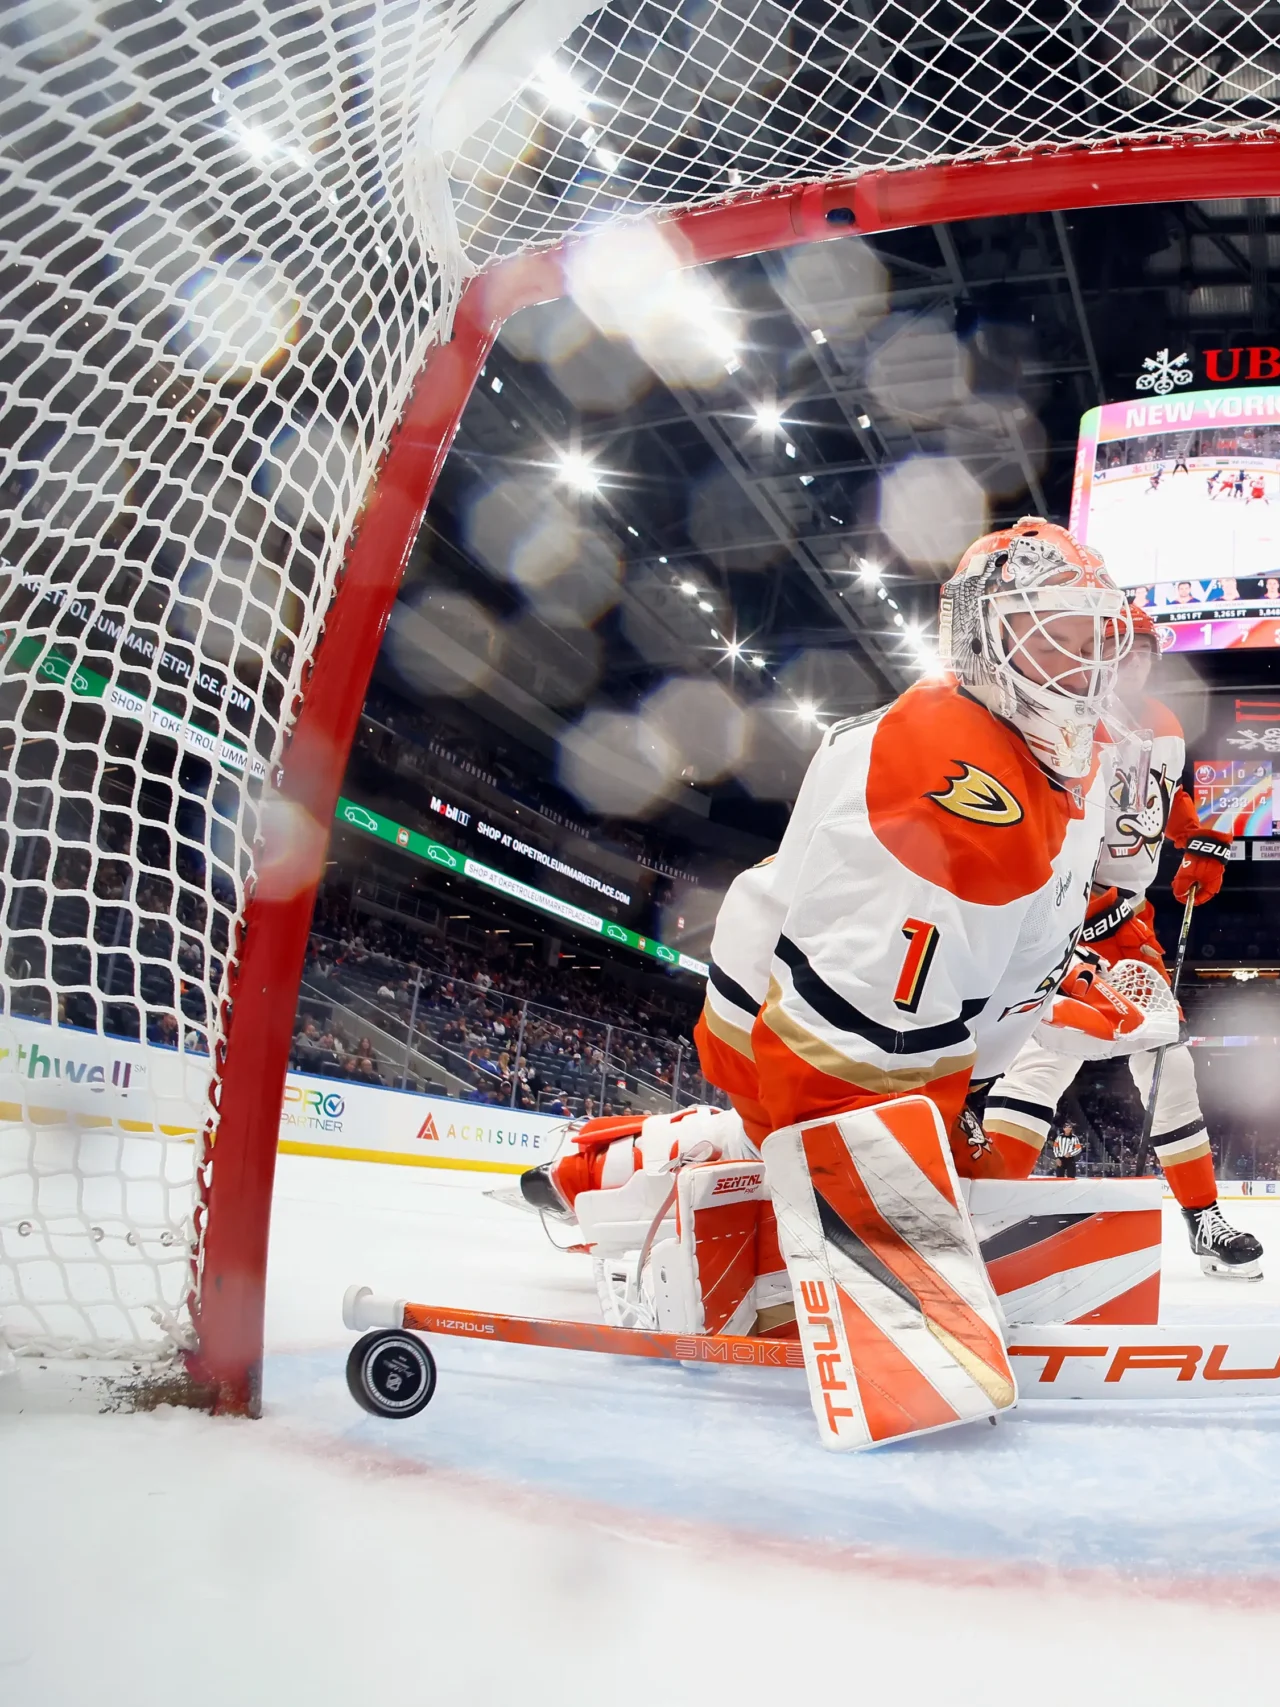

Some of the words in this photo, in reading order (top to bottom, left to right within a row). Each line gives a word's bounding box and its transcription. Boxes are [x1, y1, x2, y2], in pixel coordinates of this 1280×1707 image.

[1125, 400, 1196, 429] NEW
[1257, 579, 1264, 587] 4
[1192, 612, 1202, 620] FT
[1200, 623, 1212, 646] 1
[1241, 631, 1248, 642] 7
[110, 691, 143, 714] SHOP
[1222, 769, 1227, 778] 1
[1237, 769, 1245, 778] 0
[430, 796, 459, 823] Mobil
[1200, 797, 1206, 806] 7
[1219, 797, 1248, 808] 3:33
[1259, 797, 1266, 805] 4
[477, 821, 501, 841] SHOP
[501, 834, 512, 847] AT
[512, 838, 631, 906] OKPETROLEUMMARKETPLACE.COM
[637, 854, 651, 867] PAT
[468, 863, 487, 878] SHOP
[488, 873, 498, 883] AT
[1082, 899, 1132, 942] BAUE
[893, 915, 940, 1014] 1
[0, 1044, 132, 1098] thwell
[284, 1085, 345, 1118] PRO
[281, 1113, 343, 1132] PARTNER
[447, 1124, 541, 1149] ACRISURE
[436, 1319, 495, 1334] HZRDUS
[676, 1338, 805, 1366] SMOKE
[800, 1281, 854, 1436] TRUE
